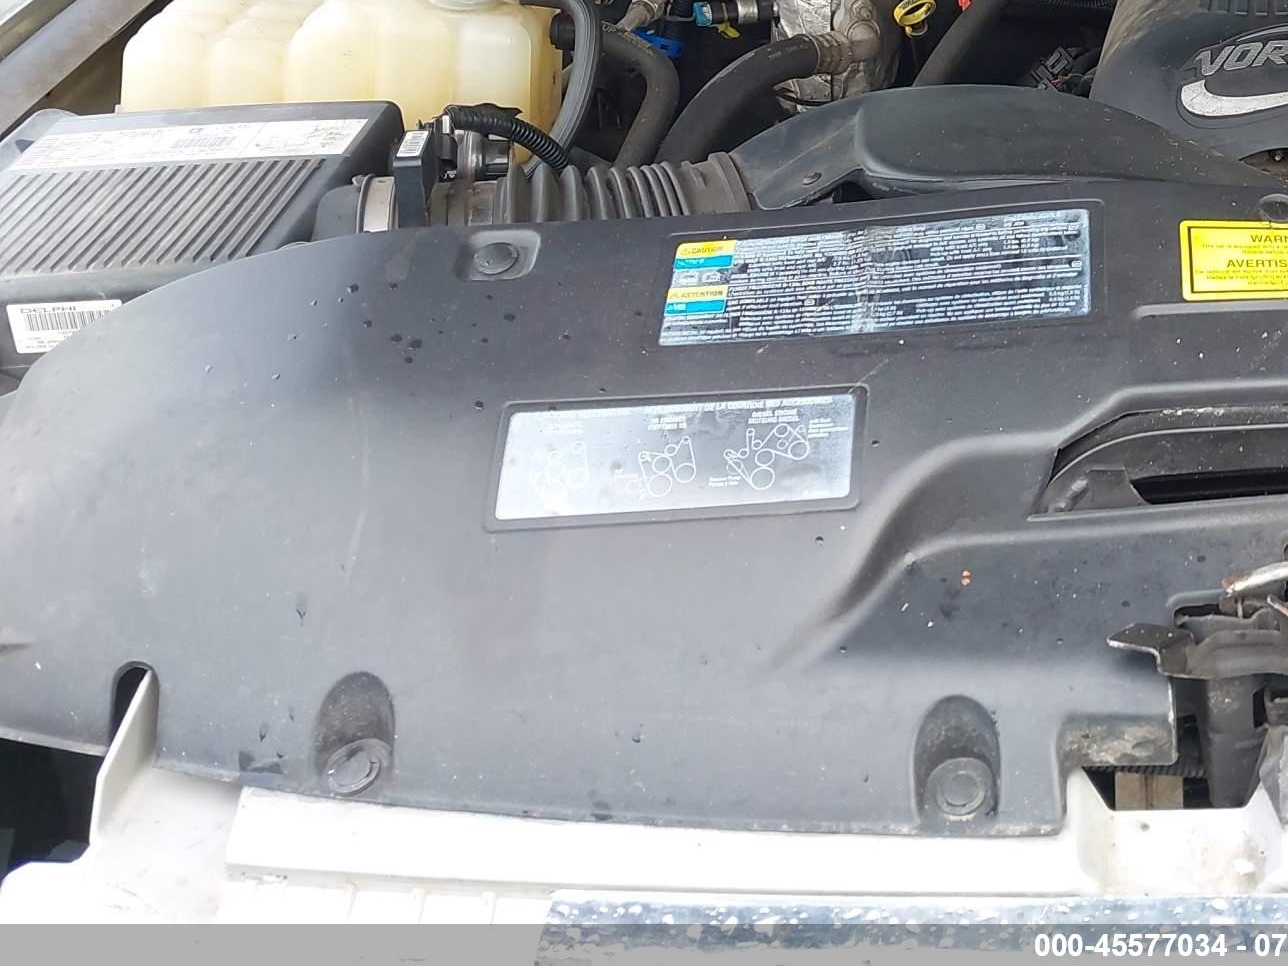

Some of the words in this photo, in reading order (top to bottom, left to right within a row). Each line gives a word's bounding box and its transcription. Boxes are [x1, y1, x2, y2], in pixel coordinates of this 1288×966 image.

[691, 246, 724, 254] CAUTION
[682, 290, 723, 299] ATTENTION
[20, 305, 77, 314] DELPHI
